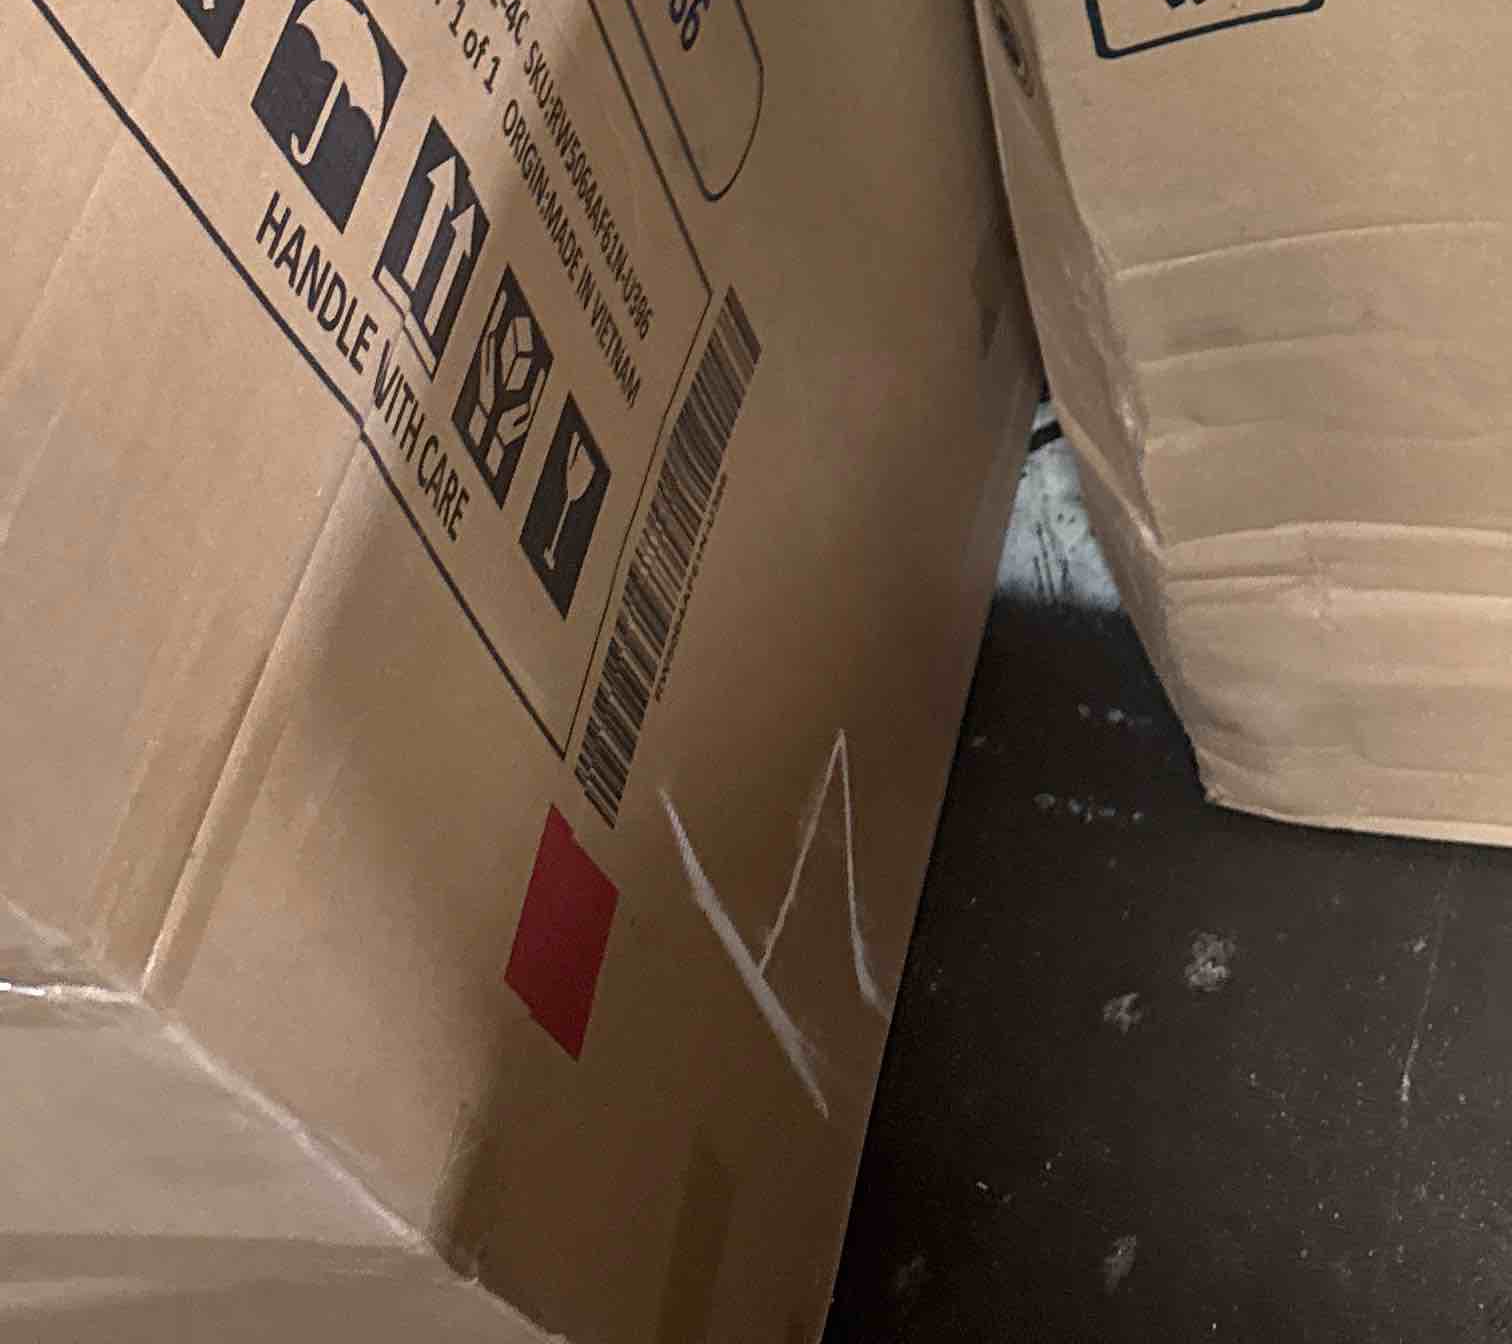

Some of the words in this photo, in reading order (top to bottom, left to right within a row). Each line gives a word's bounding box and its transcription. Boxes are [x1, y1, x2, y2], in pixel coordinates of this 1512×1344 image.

[449, 0, 466, 38] 1
[464, 28, 490, 70] of
[483, 56, 501, 95] 1
[255, 190, 378, 376] HANDLE
[418, 434, 470, 543] CARE
[576, 263, 596, 311] IN
[591, 290, 641, 409] VIETNAM
